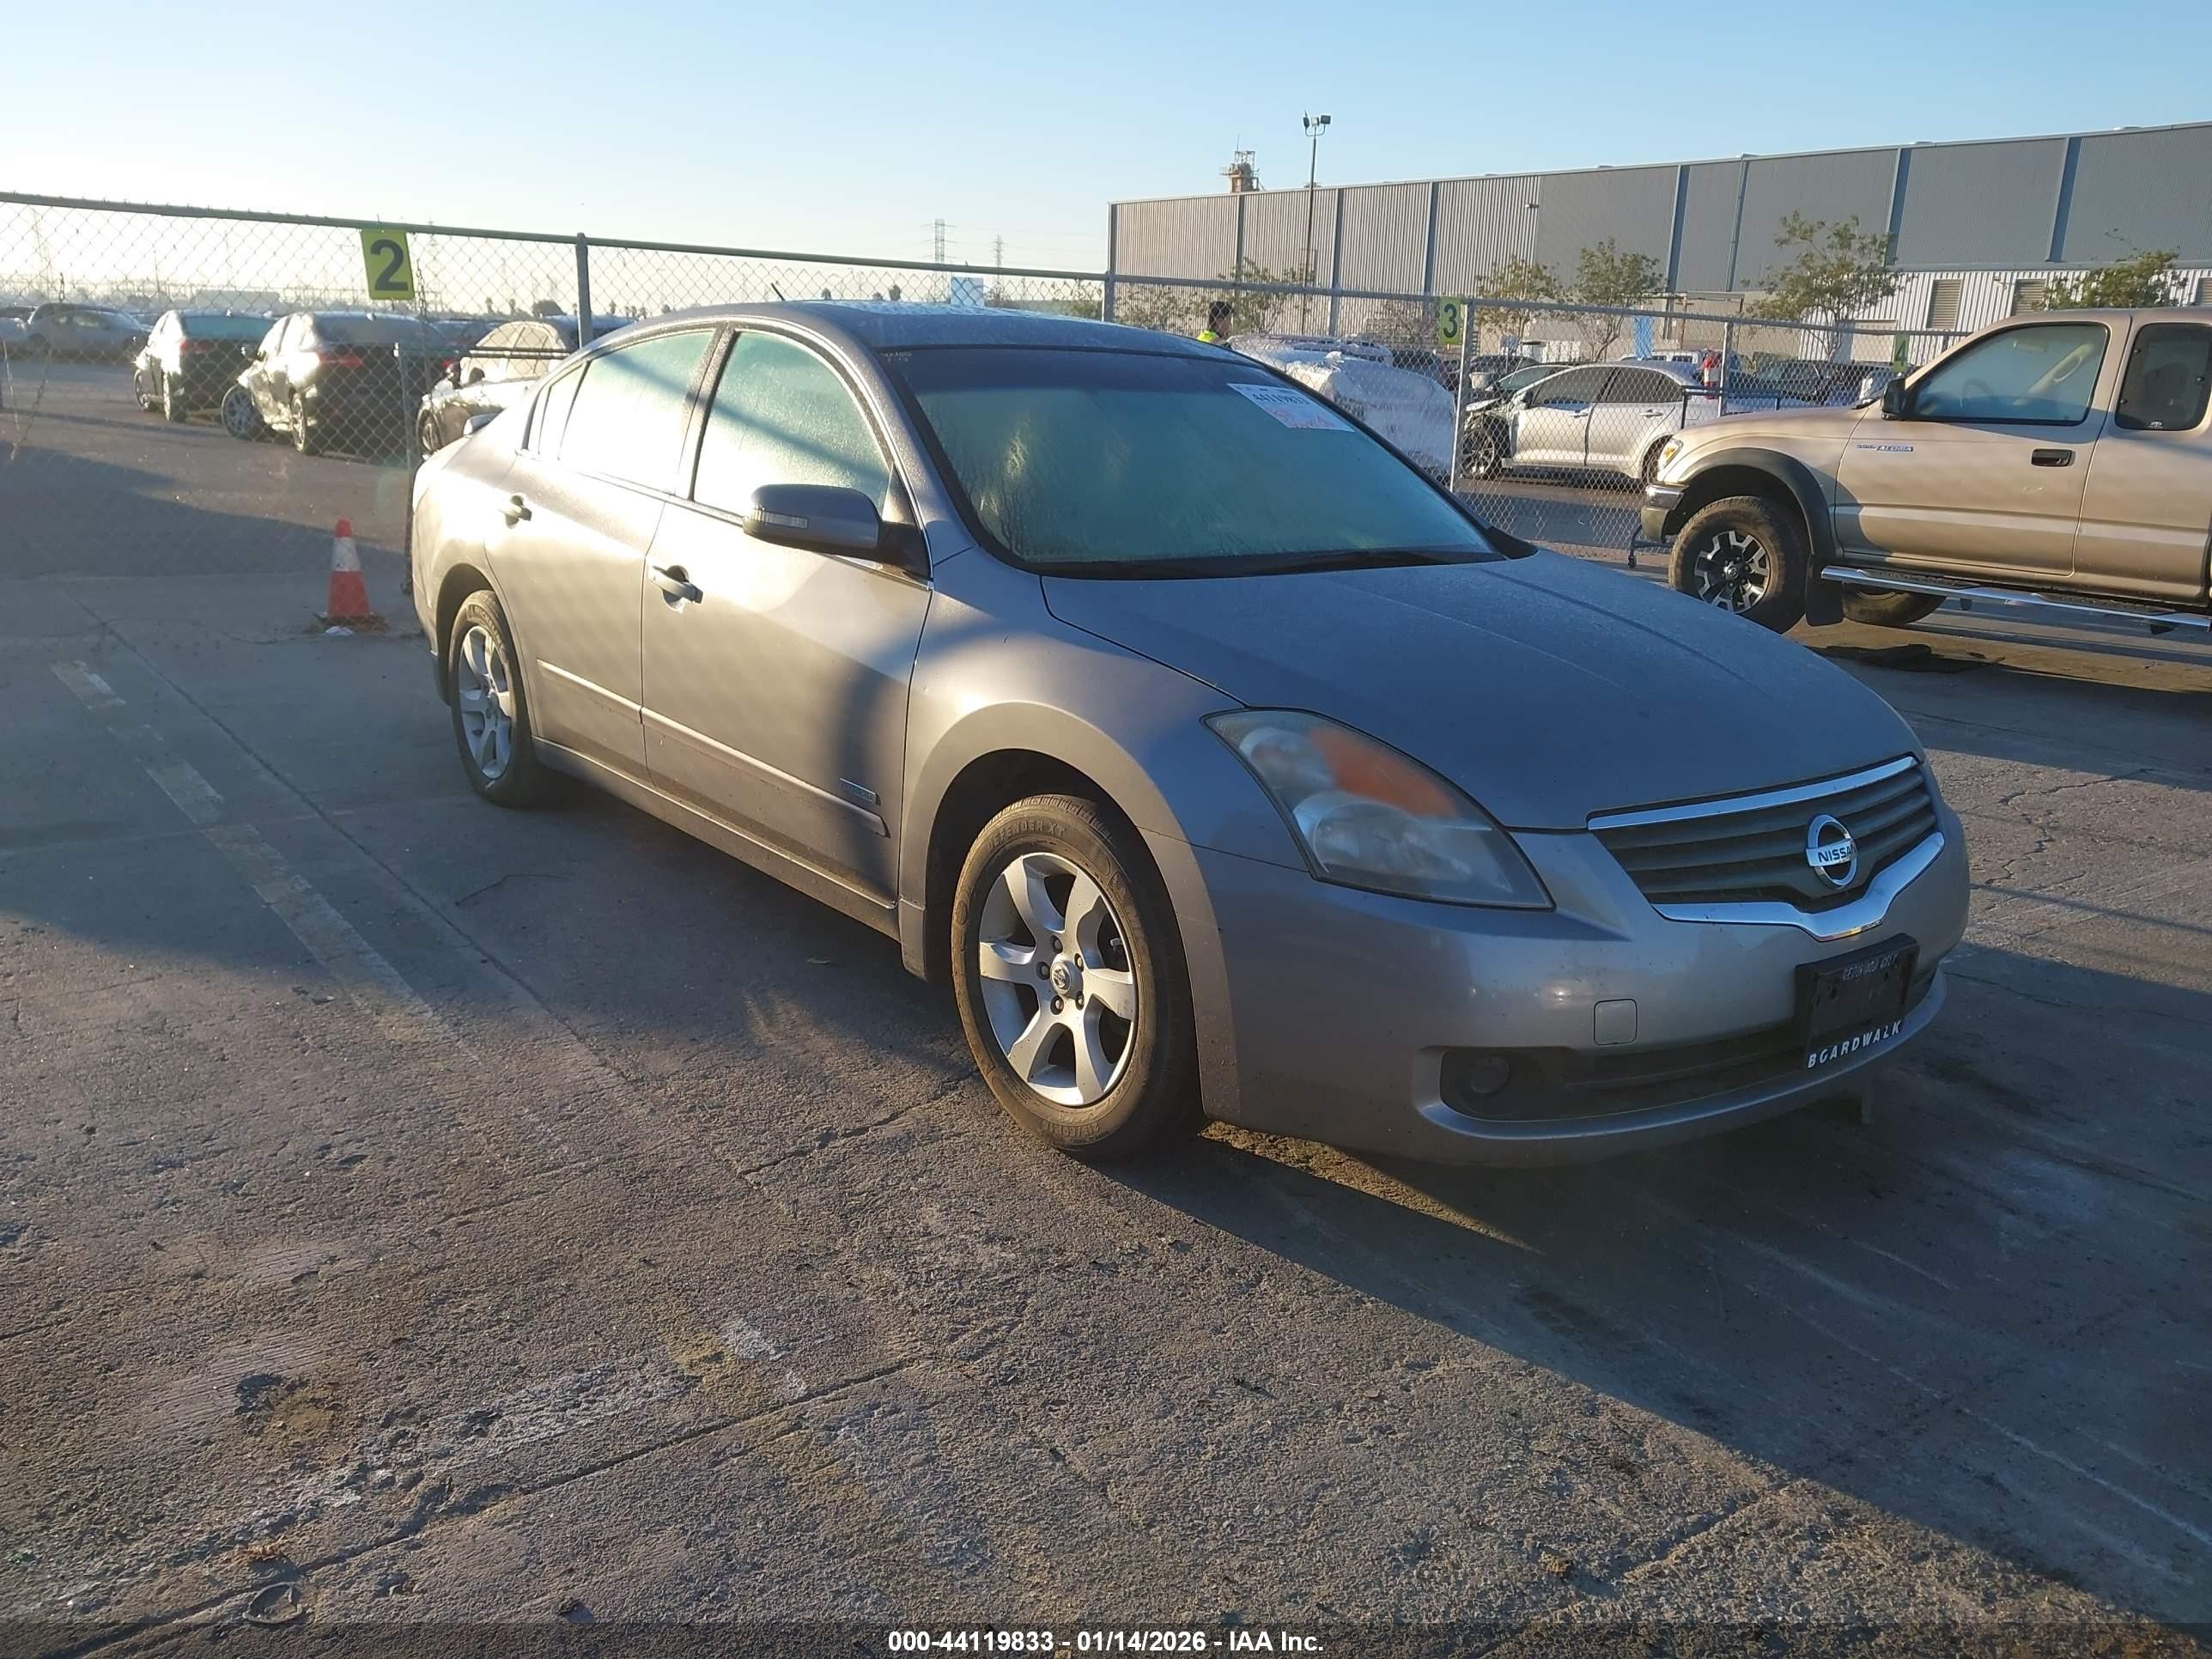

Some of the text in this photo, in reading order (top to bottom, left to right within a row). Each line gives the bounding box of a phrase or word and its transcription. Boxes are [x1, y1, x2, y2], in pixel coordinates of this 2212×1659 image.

[370, 239, 410, 291] 2
[1443, 303, 1458, 338] 3
[1894, 340, 1907, 367] 4
[1808, 1020, 1901, 1068] BOARDWALK
